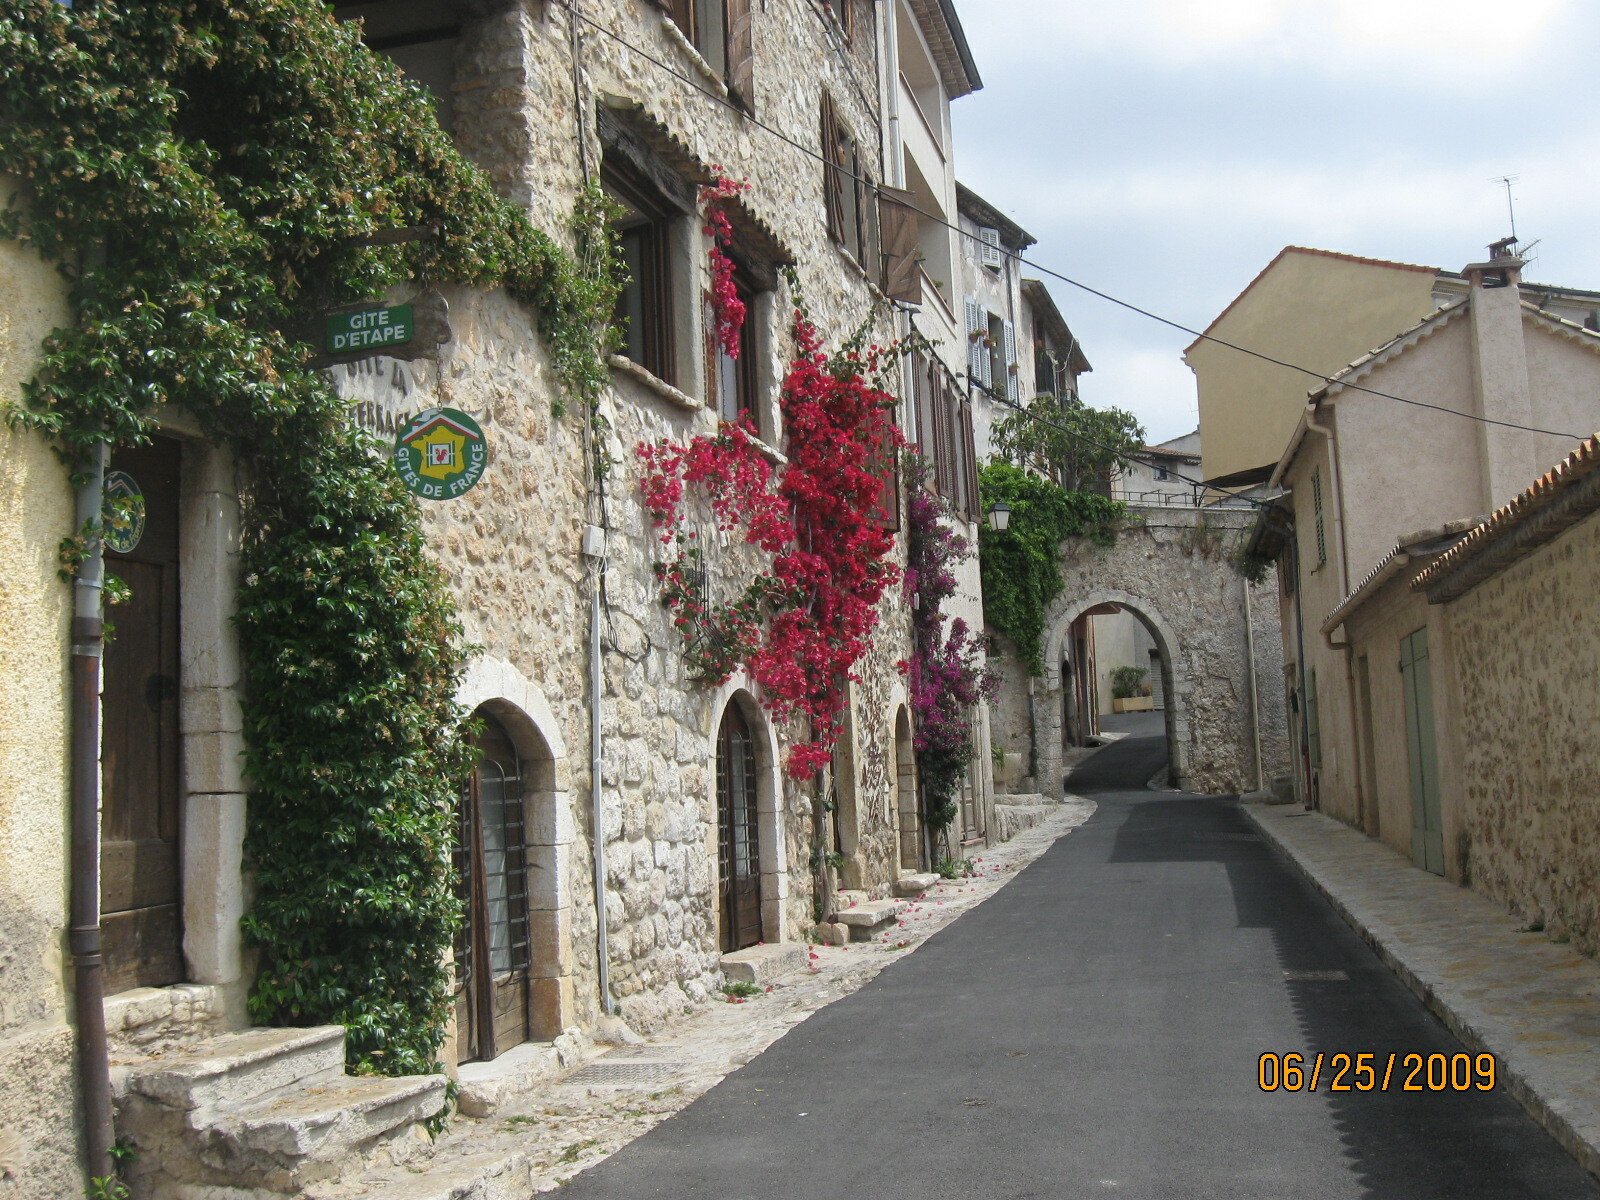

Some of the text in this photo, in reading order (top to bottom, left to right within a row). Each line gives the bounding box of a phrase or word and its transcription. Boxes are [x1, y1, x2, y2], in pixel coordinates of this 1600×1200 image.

[334, 324, 405, 349] D'ETAPE
[398, 443, 484, 497] GITES DE FRANCE
